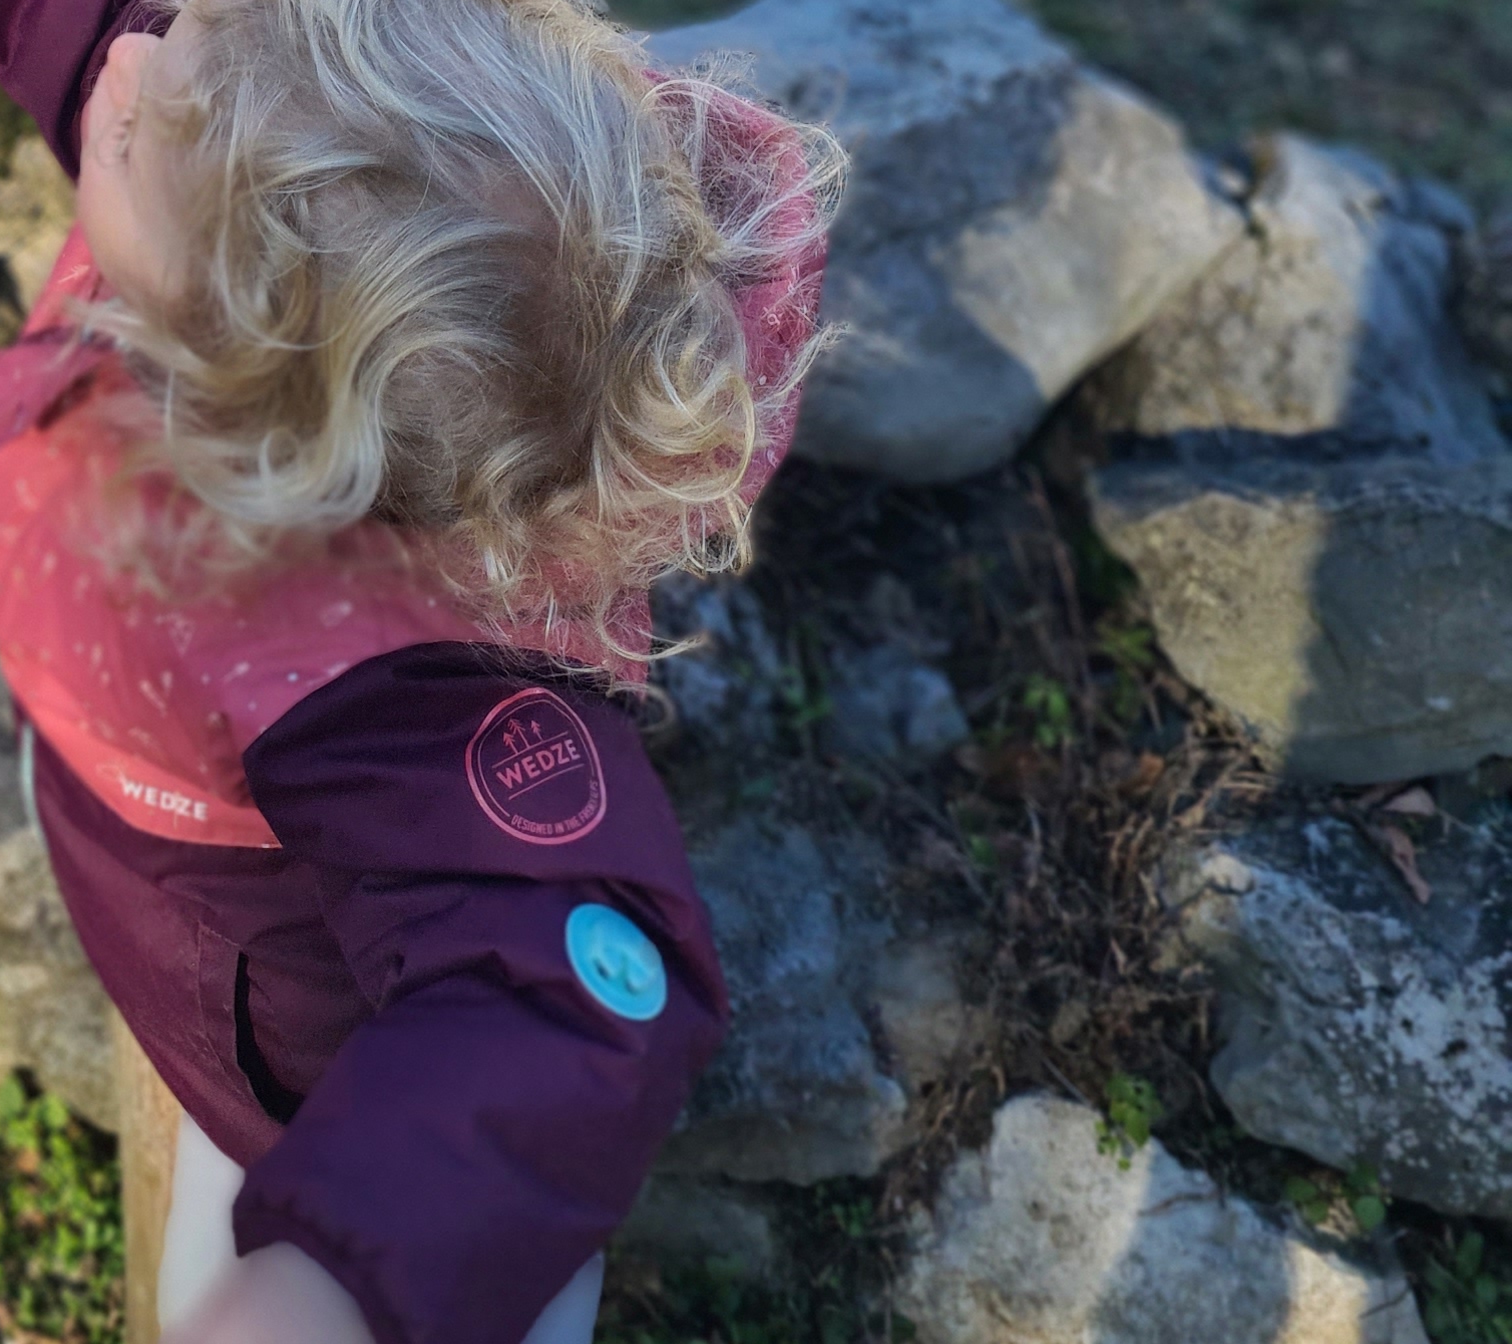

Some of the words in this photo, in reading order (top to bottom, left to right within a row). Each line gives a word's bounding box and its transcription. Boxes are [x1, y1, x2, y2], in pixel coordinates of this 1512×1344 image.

[496, 739, 580, 789] WEDZE
[118, 771, 208, 822] WEDZE
[511, 814, 553, 835] DESIGNED
